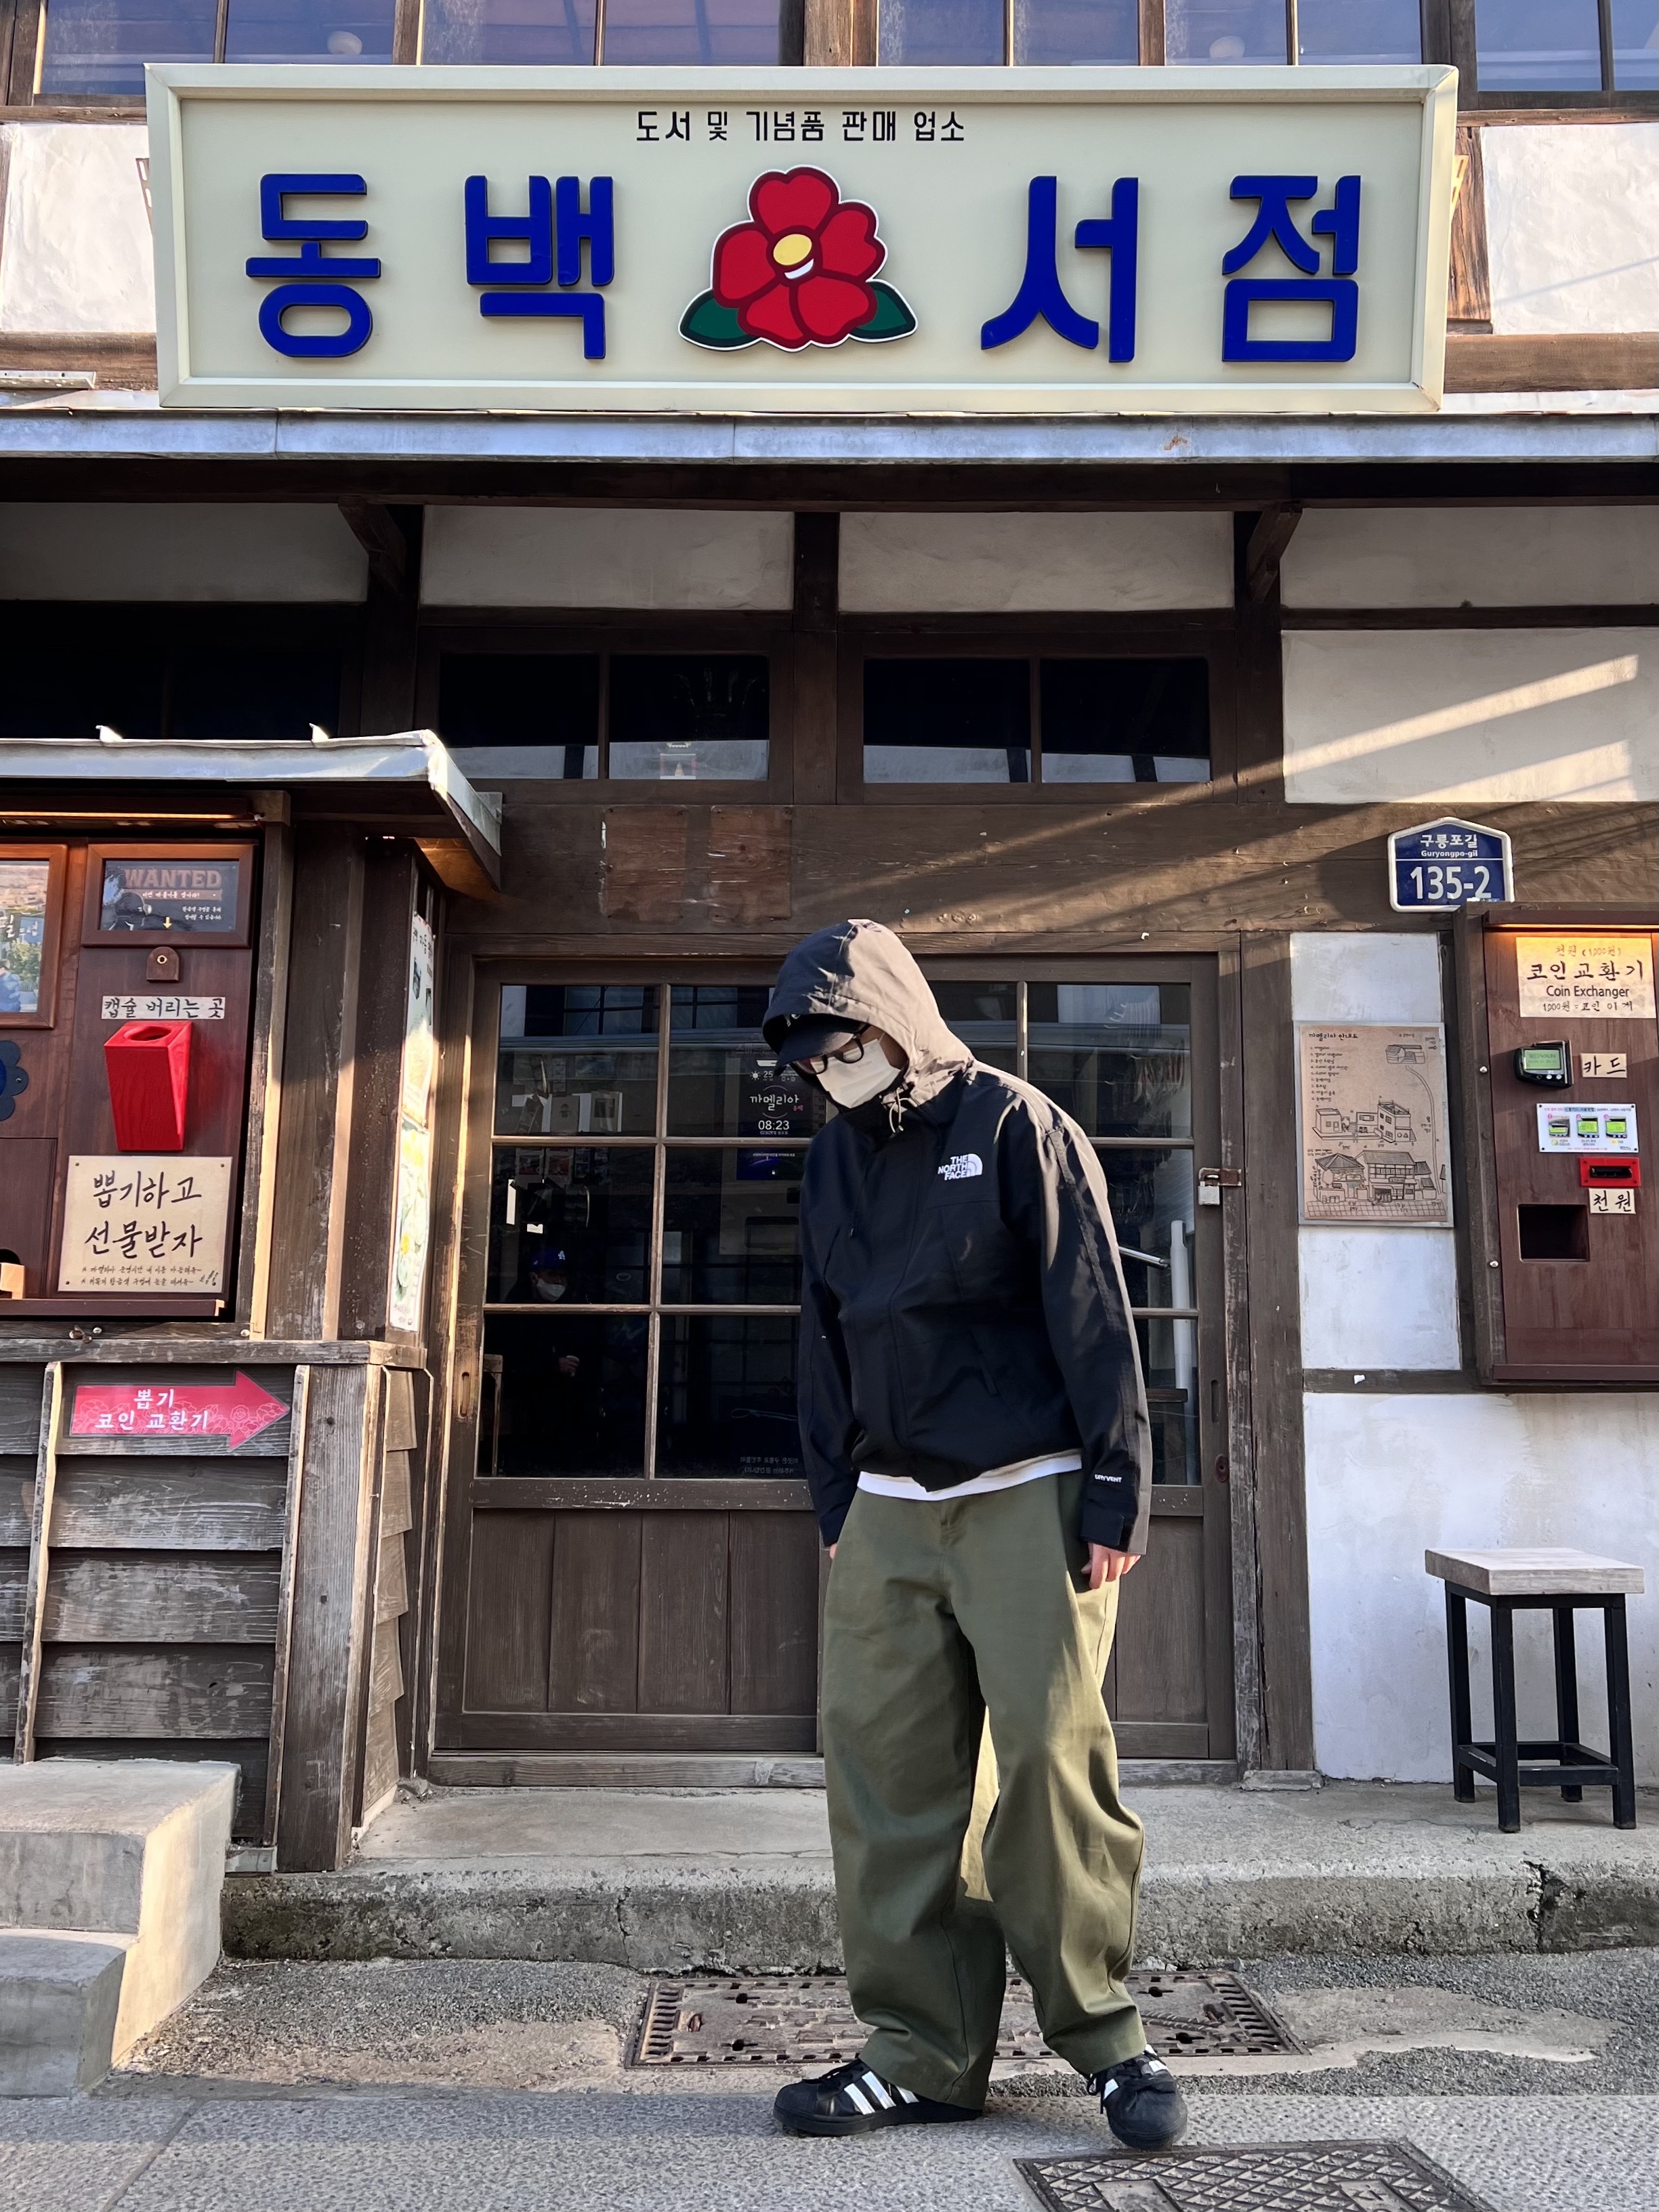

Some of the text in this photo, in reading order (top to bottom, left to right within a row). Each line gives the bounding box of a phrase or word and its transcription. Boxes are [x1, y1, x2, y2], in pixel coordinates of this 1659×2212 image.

[636, 110, 965, 142] 도서 및 기념품 판매 업소
[247, 174, 1361, 362] 동백 서점
[1420, 834, 1478, 849] 구룡포길
[1421, 850, 1479, 858] Guryongpo-gil
[124, 869, 222, 889] WANTED
[1410, 866, 1492, 899] 135-2
[1527, 959, 1644, 981] 코인 교환기
[1546, 985, 1631, 1000] Coin Exchanger
[104, 997, 224, 1018] 캡슐 버리는 곳
[1583, 1055, 1626, 1076] 카드
[749, 1093, 800, 1111] 까멜리아
[758, 1120, 790, 1130] 08:23
[938, 1162, 968, 1174] NORTH
[950, 1154, 968, 1164] THE
[944, 1170, 967, 1181] FACE
[93, 1170, 203, 1210] 뽑기하고
[1593, 1190, 1632, 1212] 천원
[85, 1220, 203, 1259] 선물받자
[133, 1388, 175, 1410] 뽑기
[94, 1409, 209, 1432] 코인 교환기
